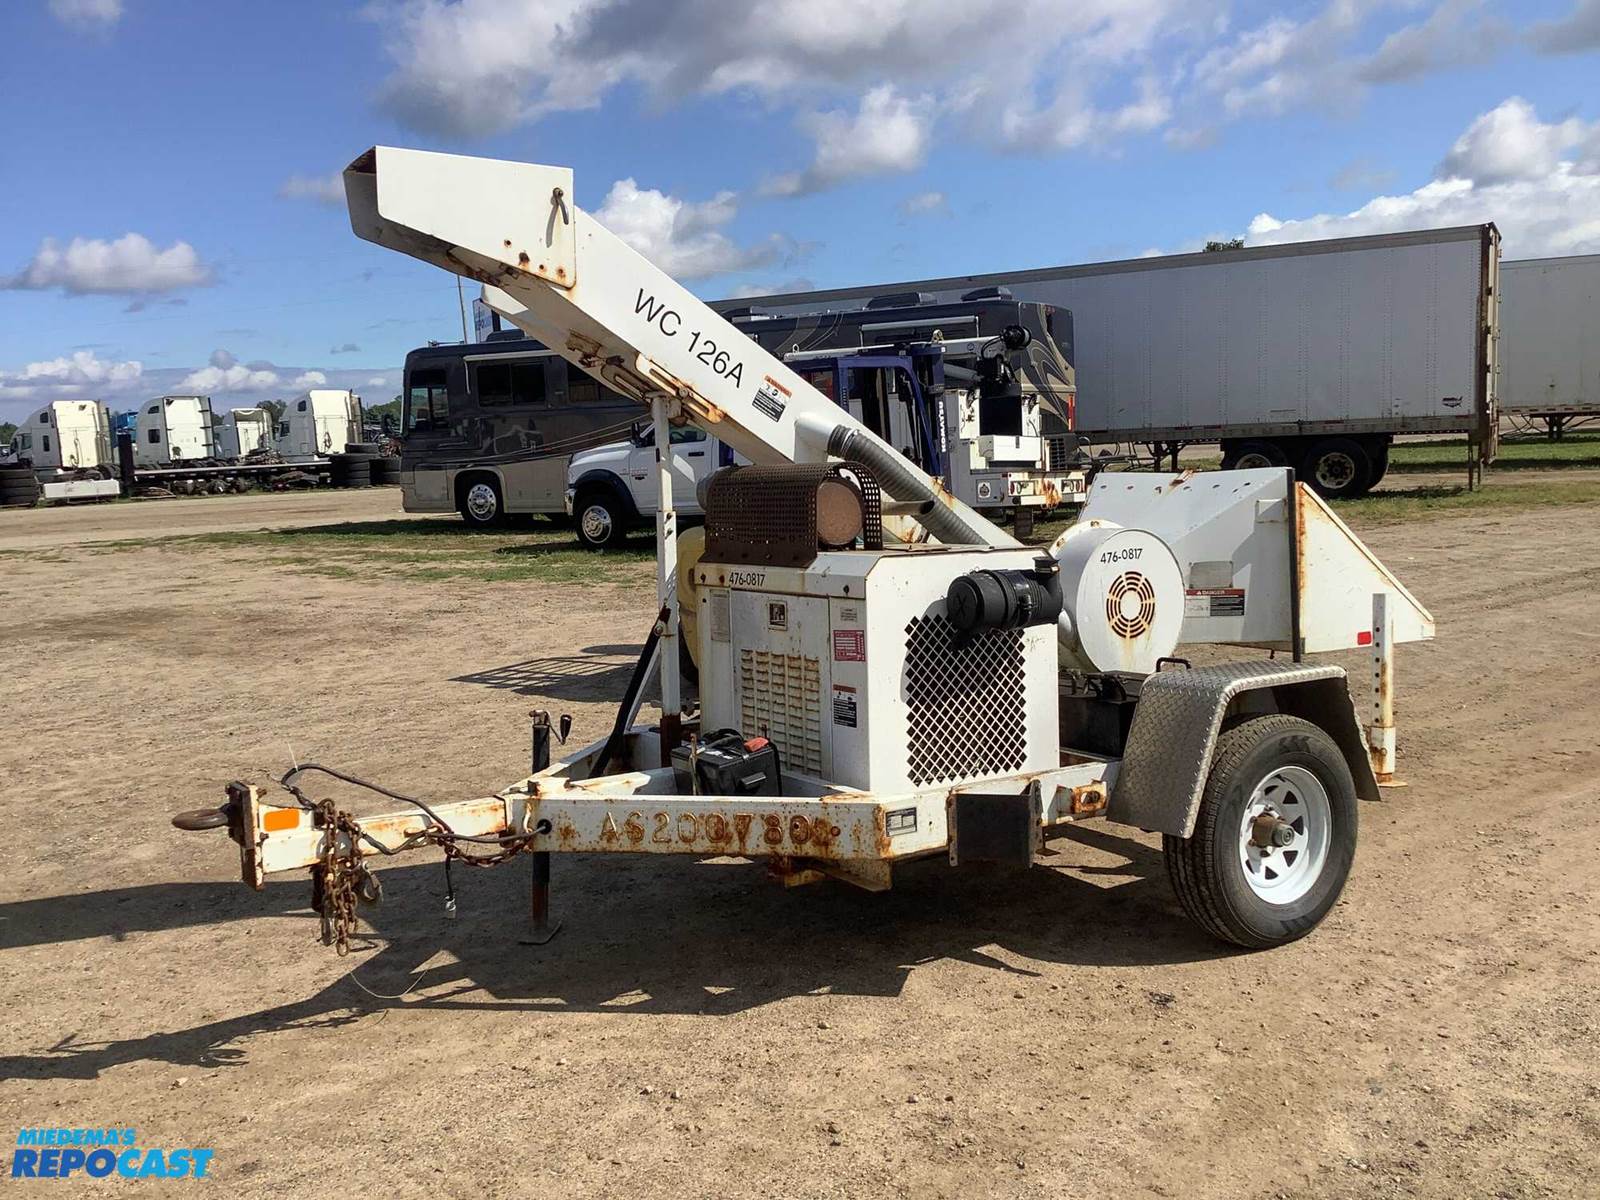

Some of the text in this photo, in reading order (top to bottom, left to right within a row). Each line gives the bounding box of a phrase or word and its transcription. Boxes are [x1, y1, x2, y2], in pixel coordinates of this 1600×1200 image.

[634, 287, 682, 337] WC
[686, 331, 745, 389] 126A
[938, 401, 947, 453] KOMATSU
[1100, 548, 1143, 564] 476-0817
[728, 571, 766, 587] 476-0817
